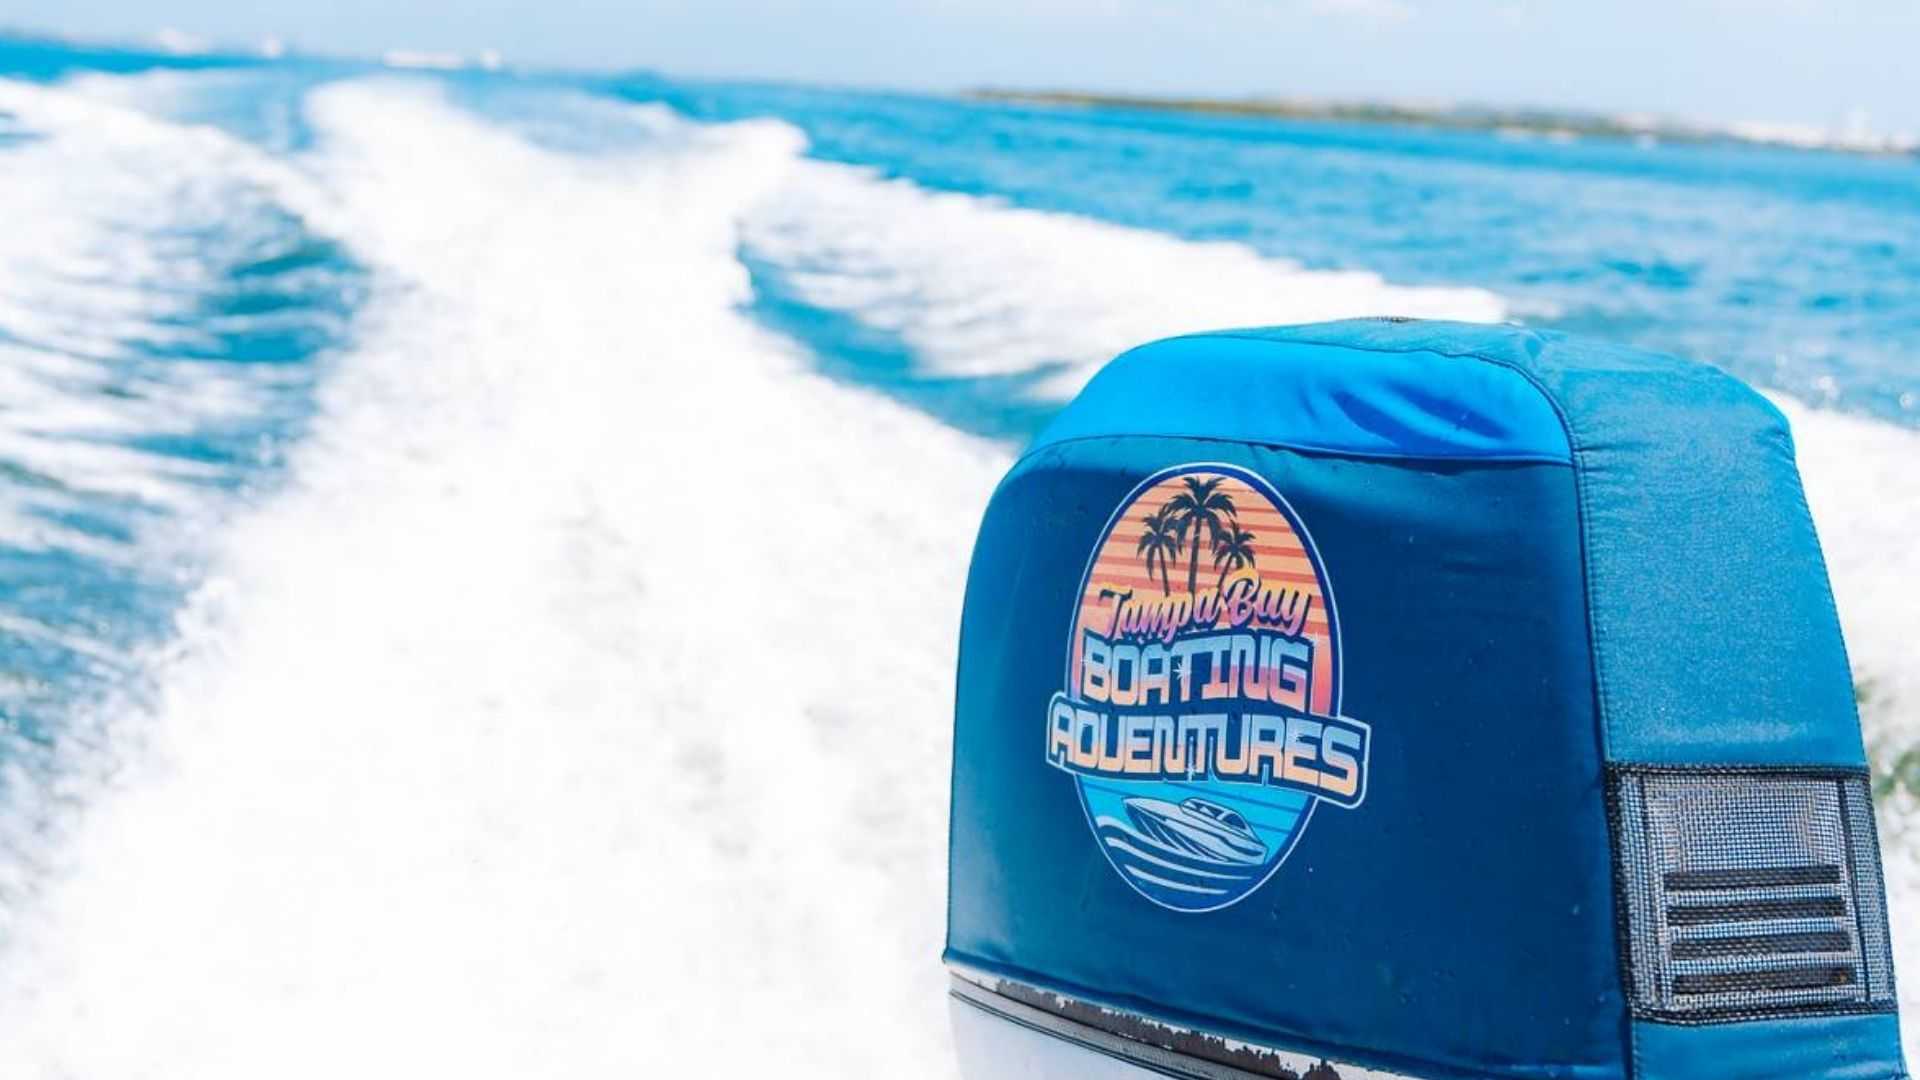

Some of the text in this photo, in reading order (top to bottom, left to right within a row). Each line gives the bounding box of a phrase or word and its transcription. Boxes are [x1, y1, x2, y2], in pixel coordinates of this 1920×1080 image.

[1100, 567, 1312, 644] Tampa Bay
[1082, 633, 1308, 713] BOATING
[1050, 701, 1361, 797] ADVENTURES
